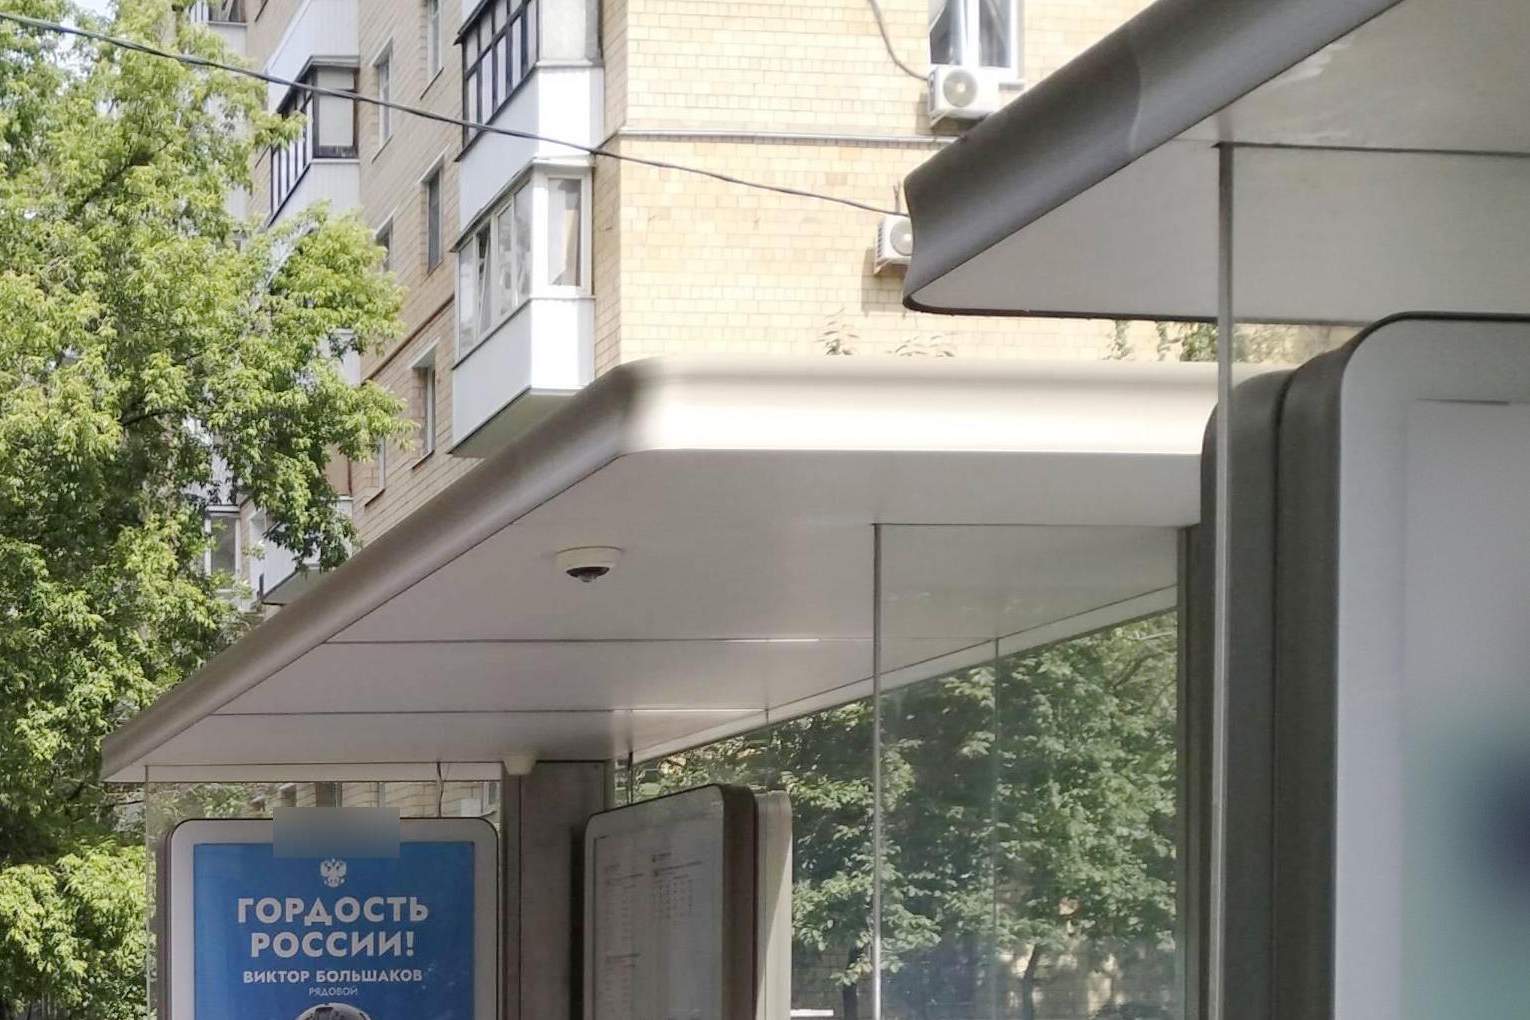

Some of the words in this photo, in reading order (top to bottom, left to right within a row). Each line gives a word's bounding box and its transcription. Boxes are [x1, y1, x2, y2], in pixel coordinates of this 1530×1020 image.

[237, 896, 429, 927] ГОРДОСТЬ
[250, 930, 415, 958] РОССИИ!
[243, 970, 310, 984] ВИКТОР
[316, 969, 423, 983] БОЛЬШАКОВ
[308, 986, 359, 997] РЯДОВОЙ
